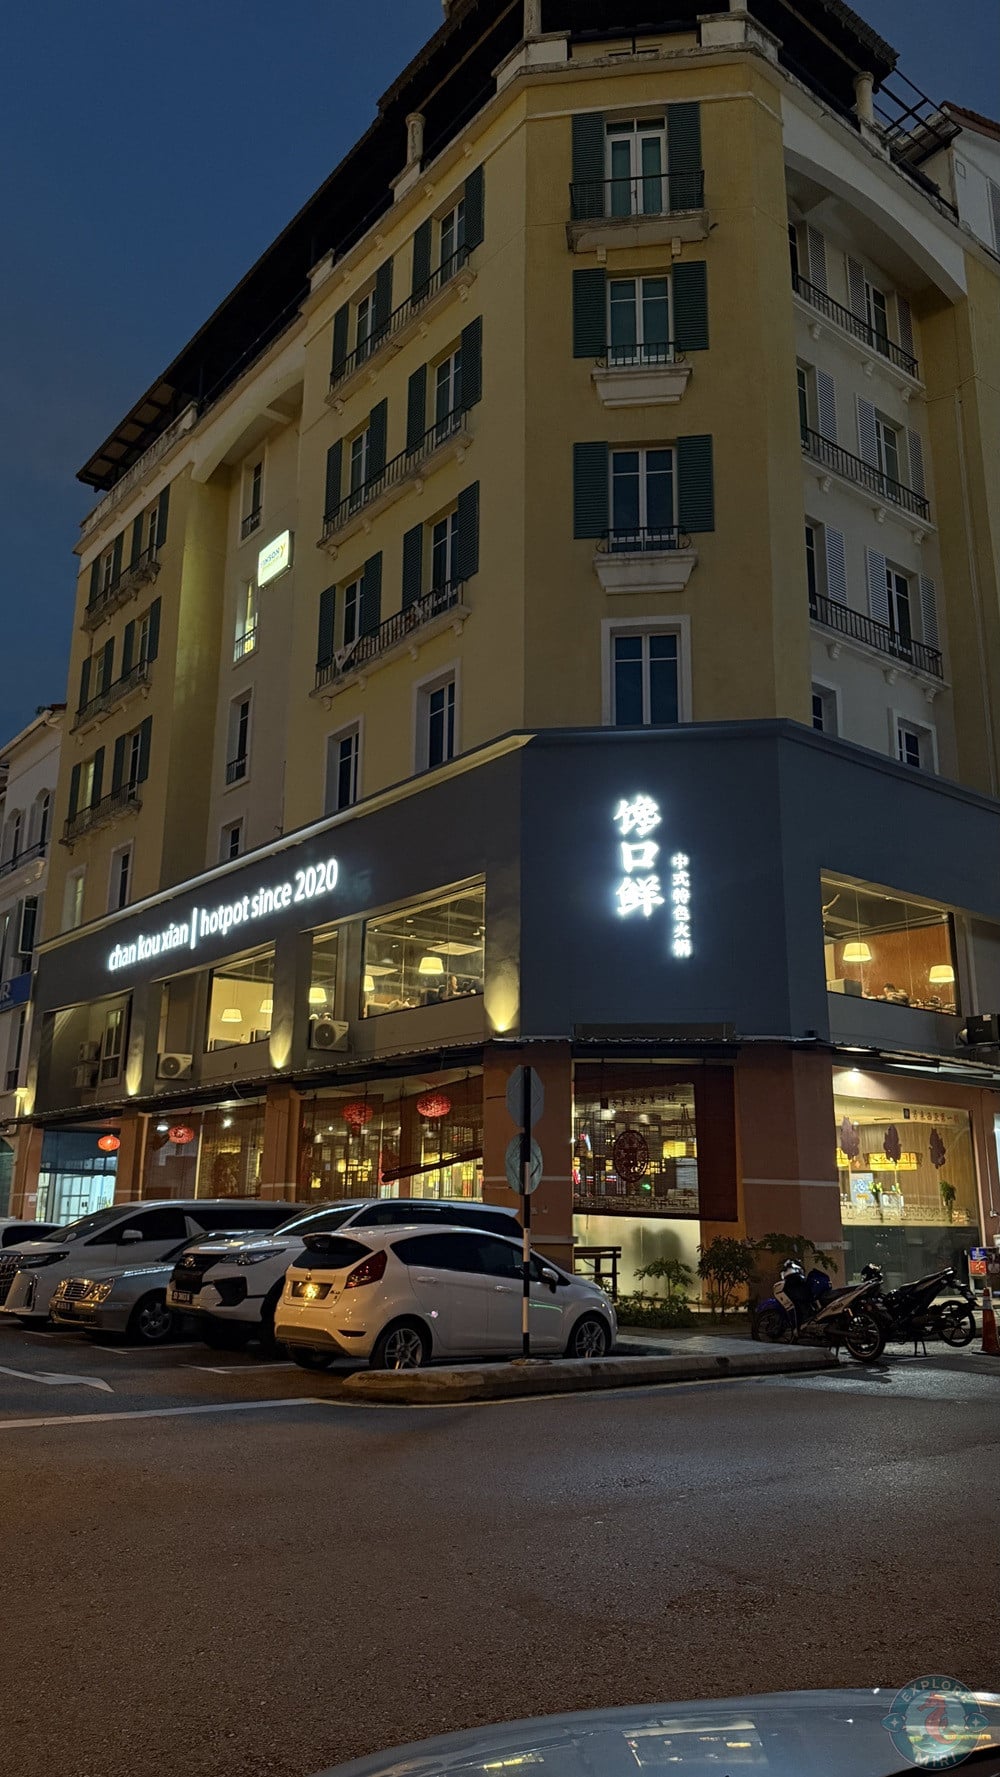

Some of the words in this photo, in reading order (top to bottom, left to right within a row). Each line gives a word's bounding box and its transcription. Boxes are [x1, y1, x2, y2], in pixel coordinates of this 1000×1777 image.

[109, 944, 136, 970] chan
[138, 935, 160, 960] kou
[161, 923, 188, 951] xian
[201, 896, 249, 934] hotpot
[252, 883, 292, 917] since
[295, 859, 338, 902] 2020
